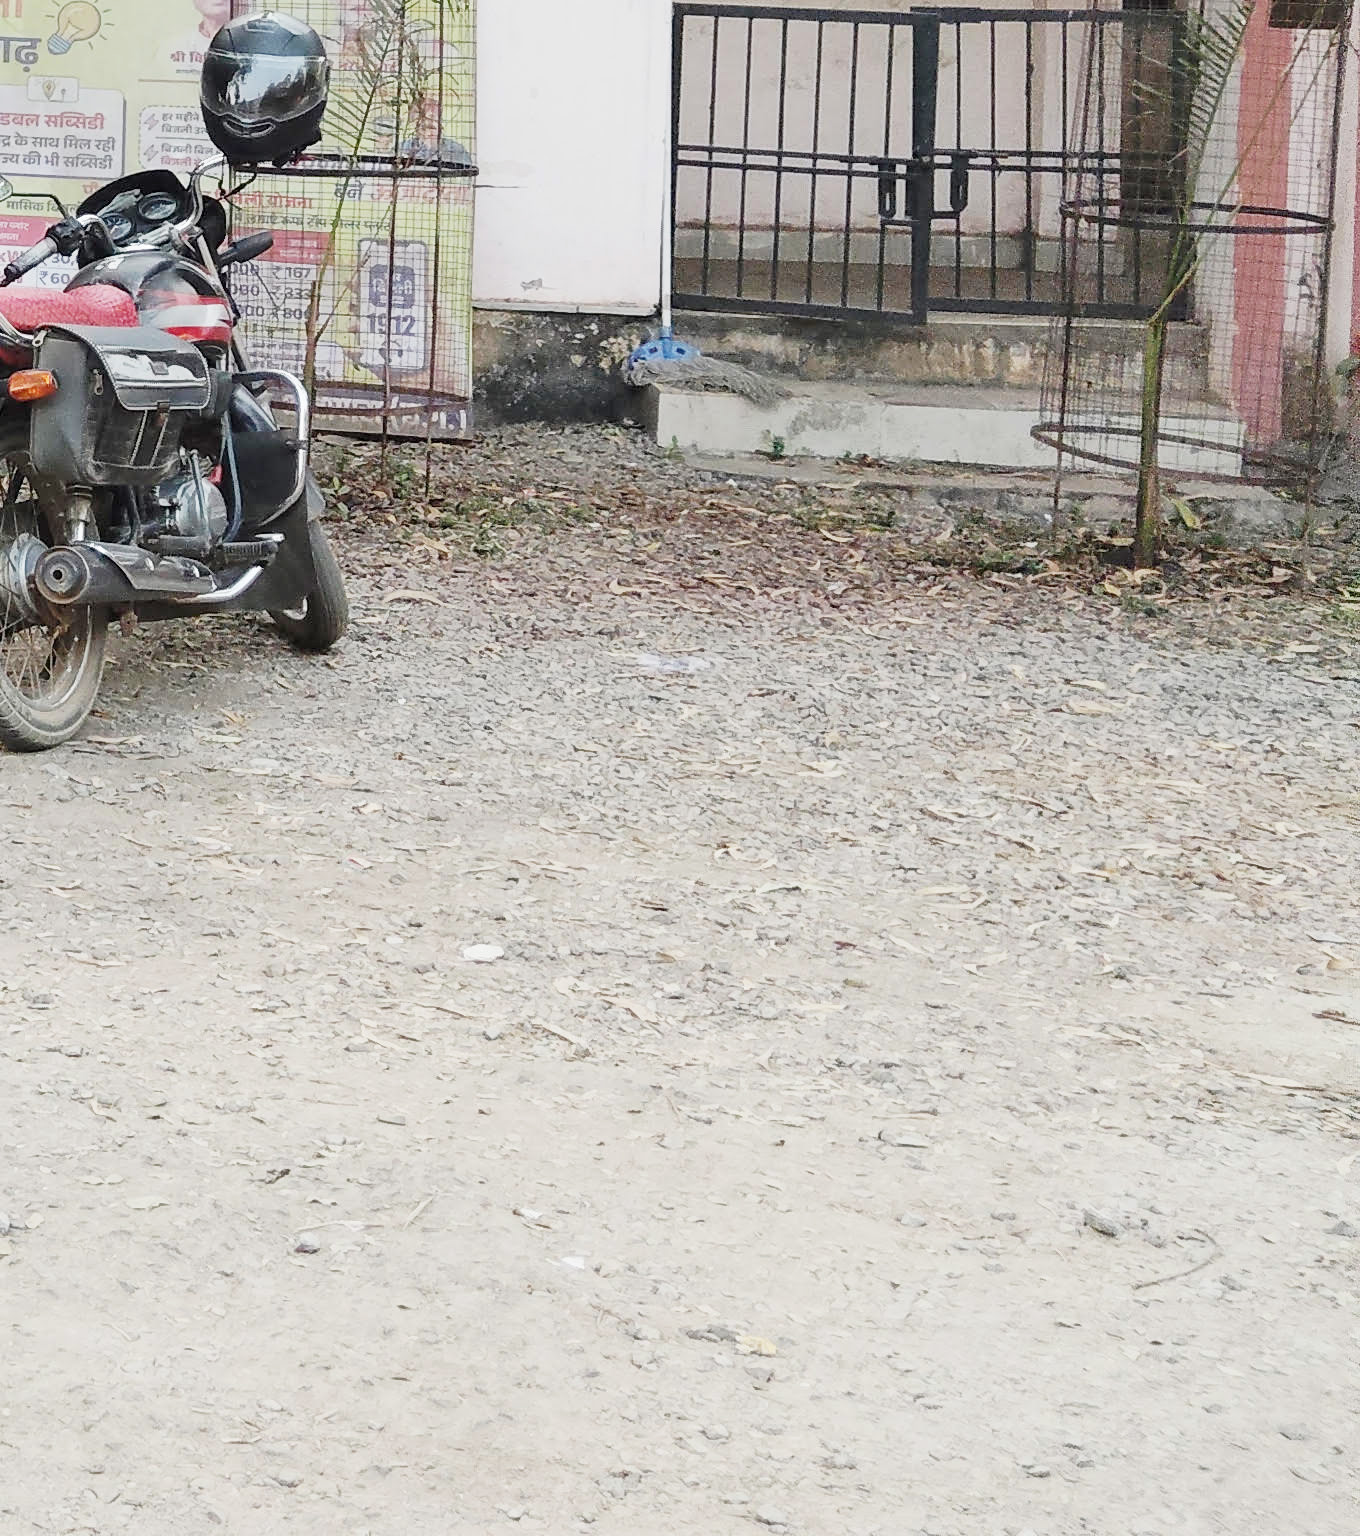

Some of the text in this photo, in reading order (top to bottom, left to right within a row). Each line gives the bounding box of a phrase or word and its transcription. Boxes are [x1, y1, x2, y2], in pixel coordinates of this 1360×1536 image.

[43, 111, 105, 130] सब्सिडी
[14, 132, 29, 146] के
[31, 135, 60, 149] साथ
[63, 134, 92, 151] मिल
[94, 136, 117, 152] रही
[22, 150, 42, 165] की
[43, 151, 60, 168] भी
[62, 153, 114, 170] सब्सिडी
